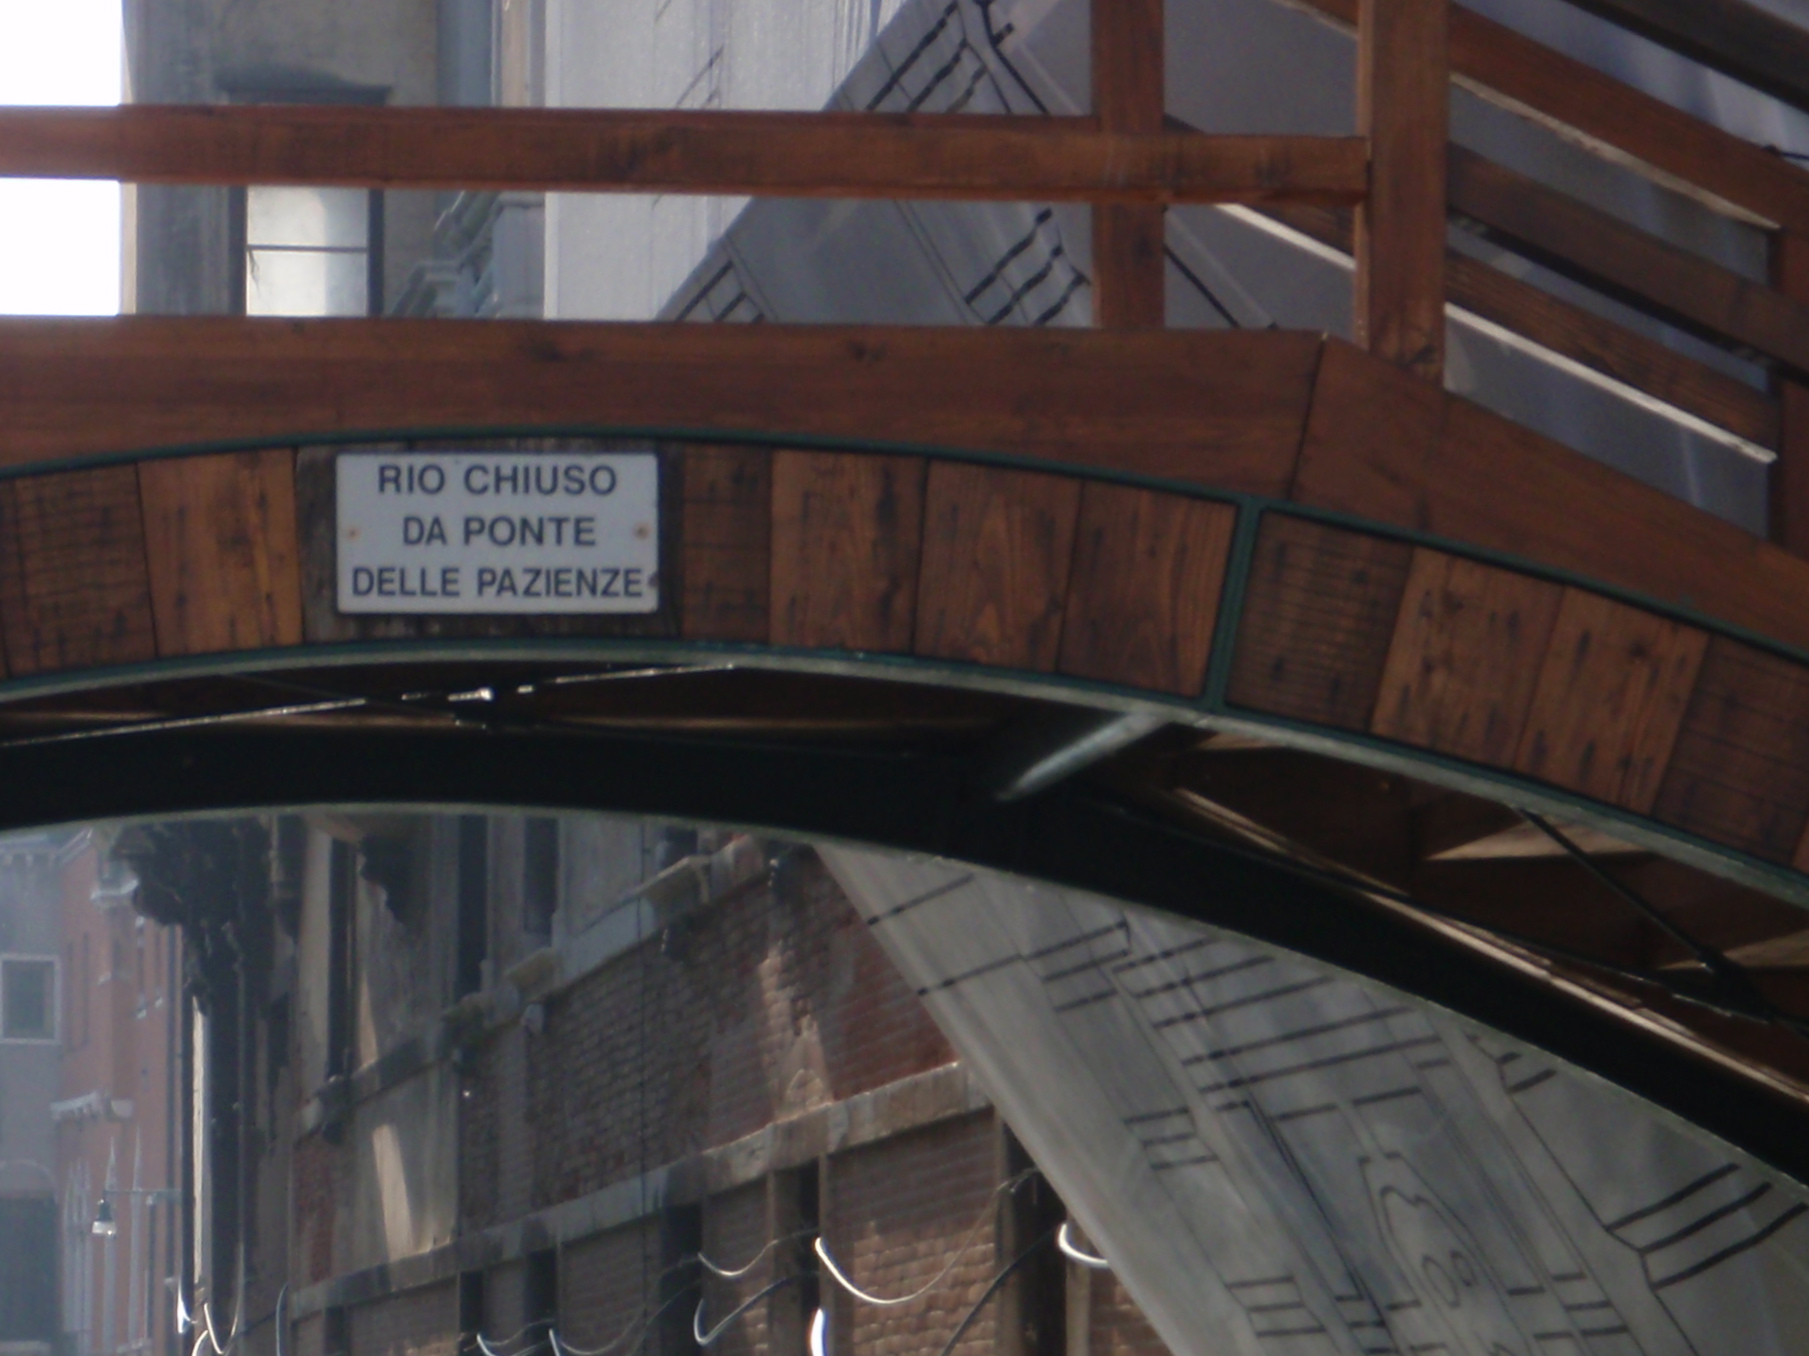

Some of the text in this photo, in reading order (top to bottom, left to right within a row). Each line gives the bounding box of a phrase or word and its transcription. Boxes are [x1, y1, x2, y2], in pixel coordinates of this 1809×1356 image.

[377, 464, 617, 496] RIO CHIUSO
[403, 516, 596, 547] DA PONTE
[352, 567, 642, 598] DELLE PAZIENZE
